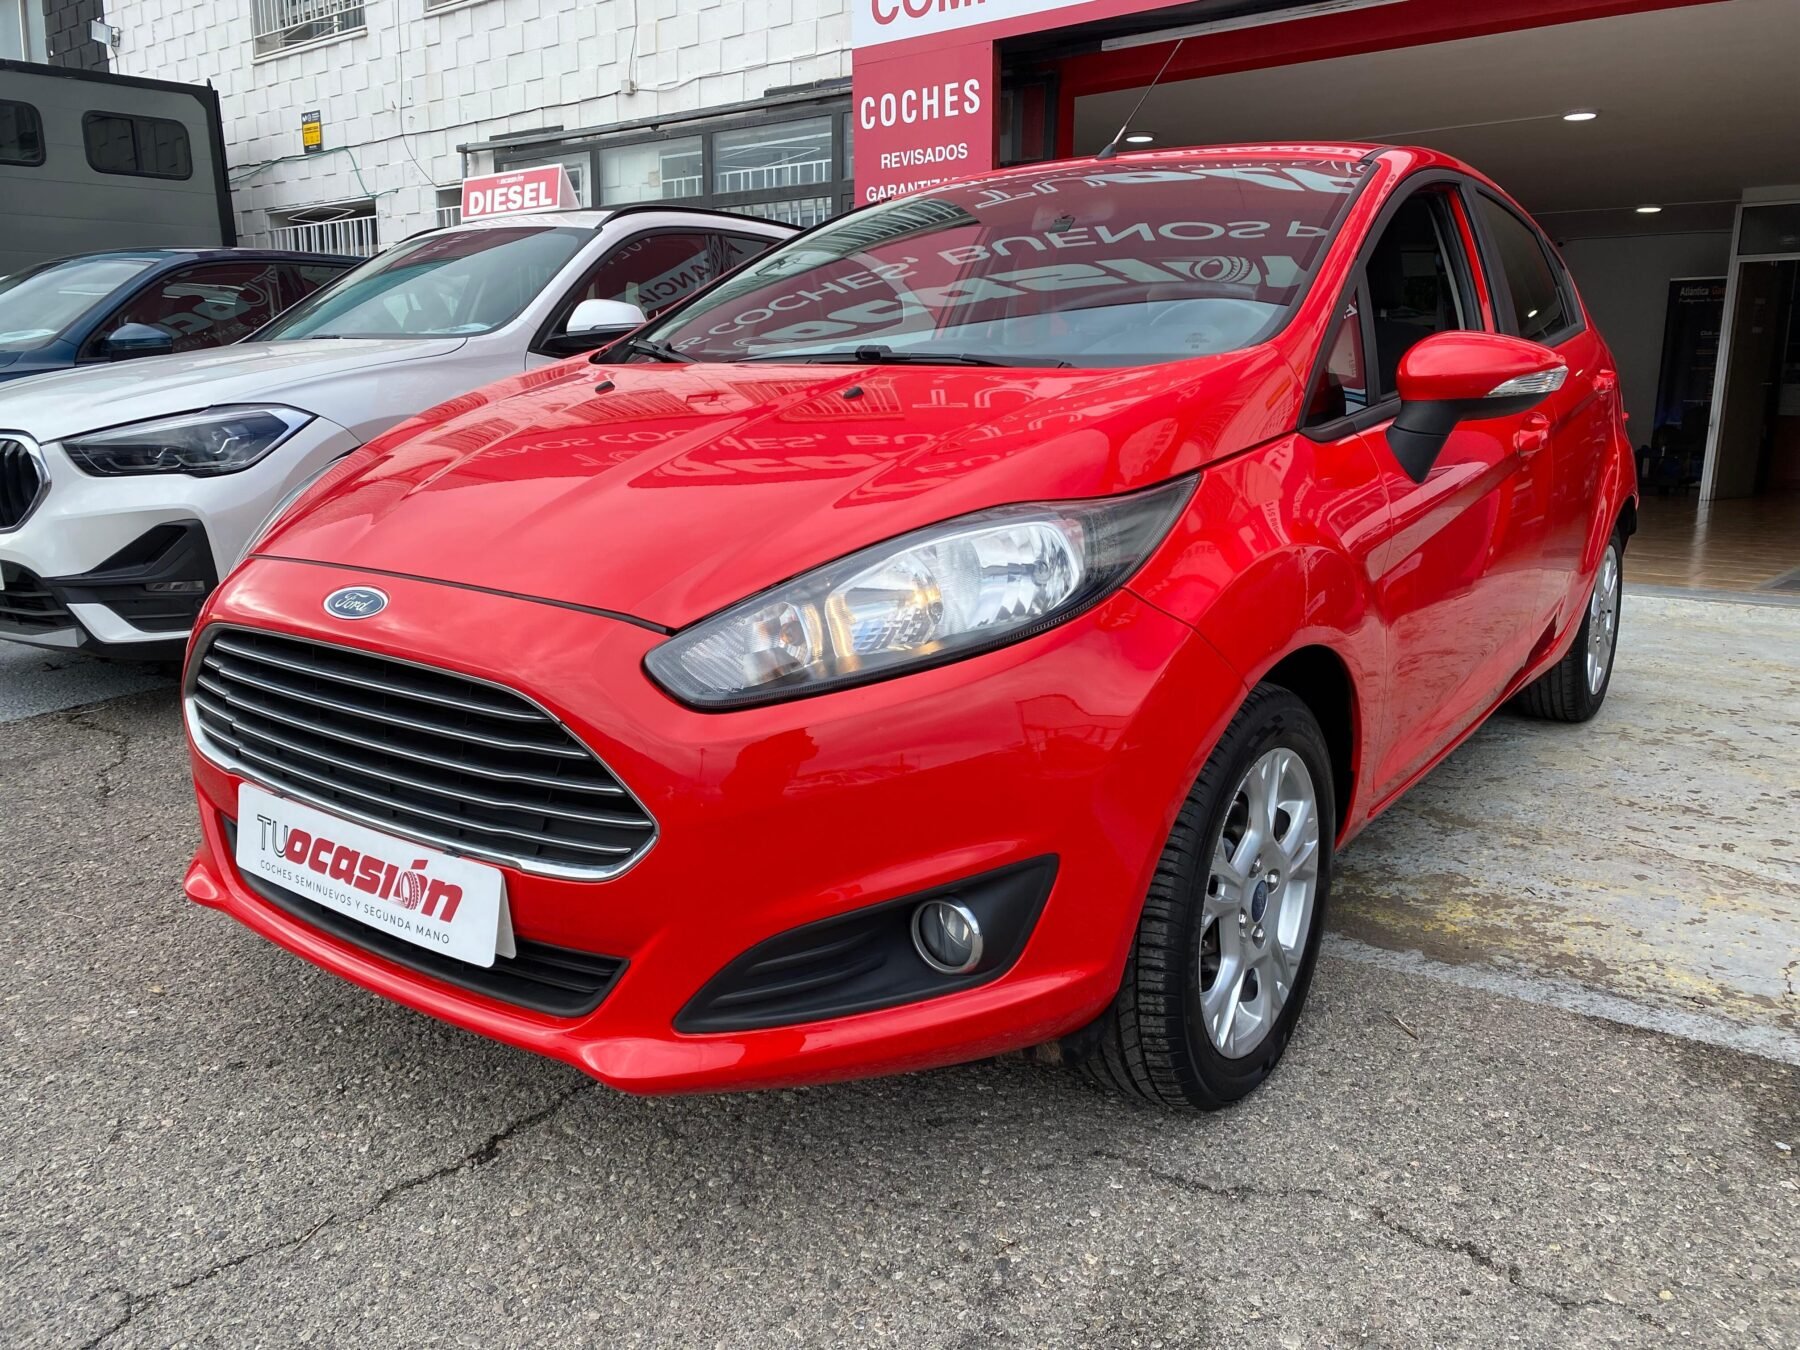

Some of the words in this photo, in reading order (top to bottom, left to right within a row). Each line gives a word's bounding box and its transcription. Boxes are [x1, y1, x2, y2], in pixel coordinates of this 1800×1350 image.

[871, 0, 985, 25] CO
[860, 78, 981, 130] COCHES
[880, 142, 968, 169] REVISADOS
[468, 181, 552, 215] DIESEL
[334, 591, 375, 612] Ford
[259, 859, 293, 882] COCHES
[294, 873, 352, 908] SEMINUEVOS
[355, 900, 361, 910] Y
[363, 903, 412, 932] SEGUNDA
[415, 923, 451, 945] MANO
